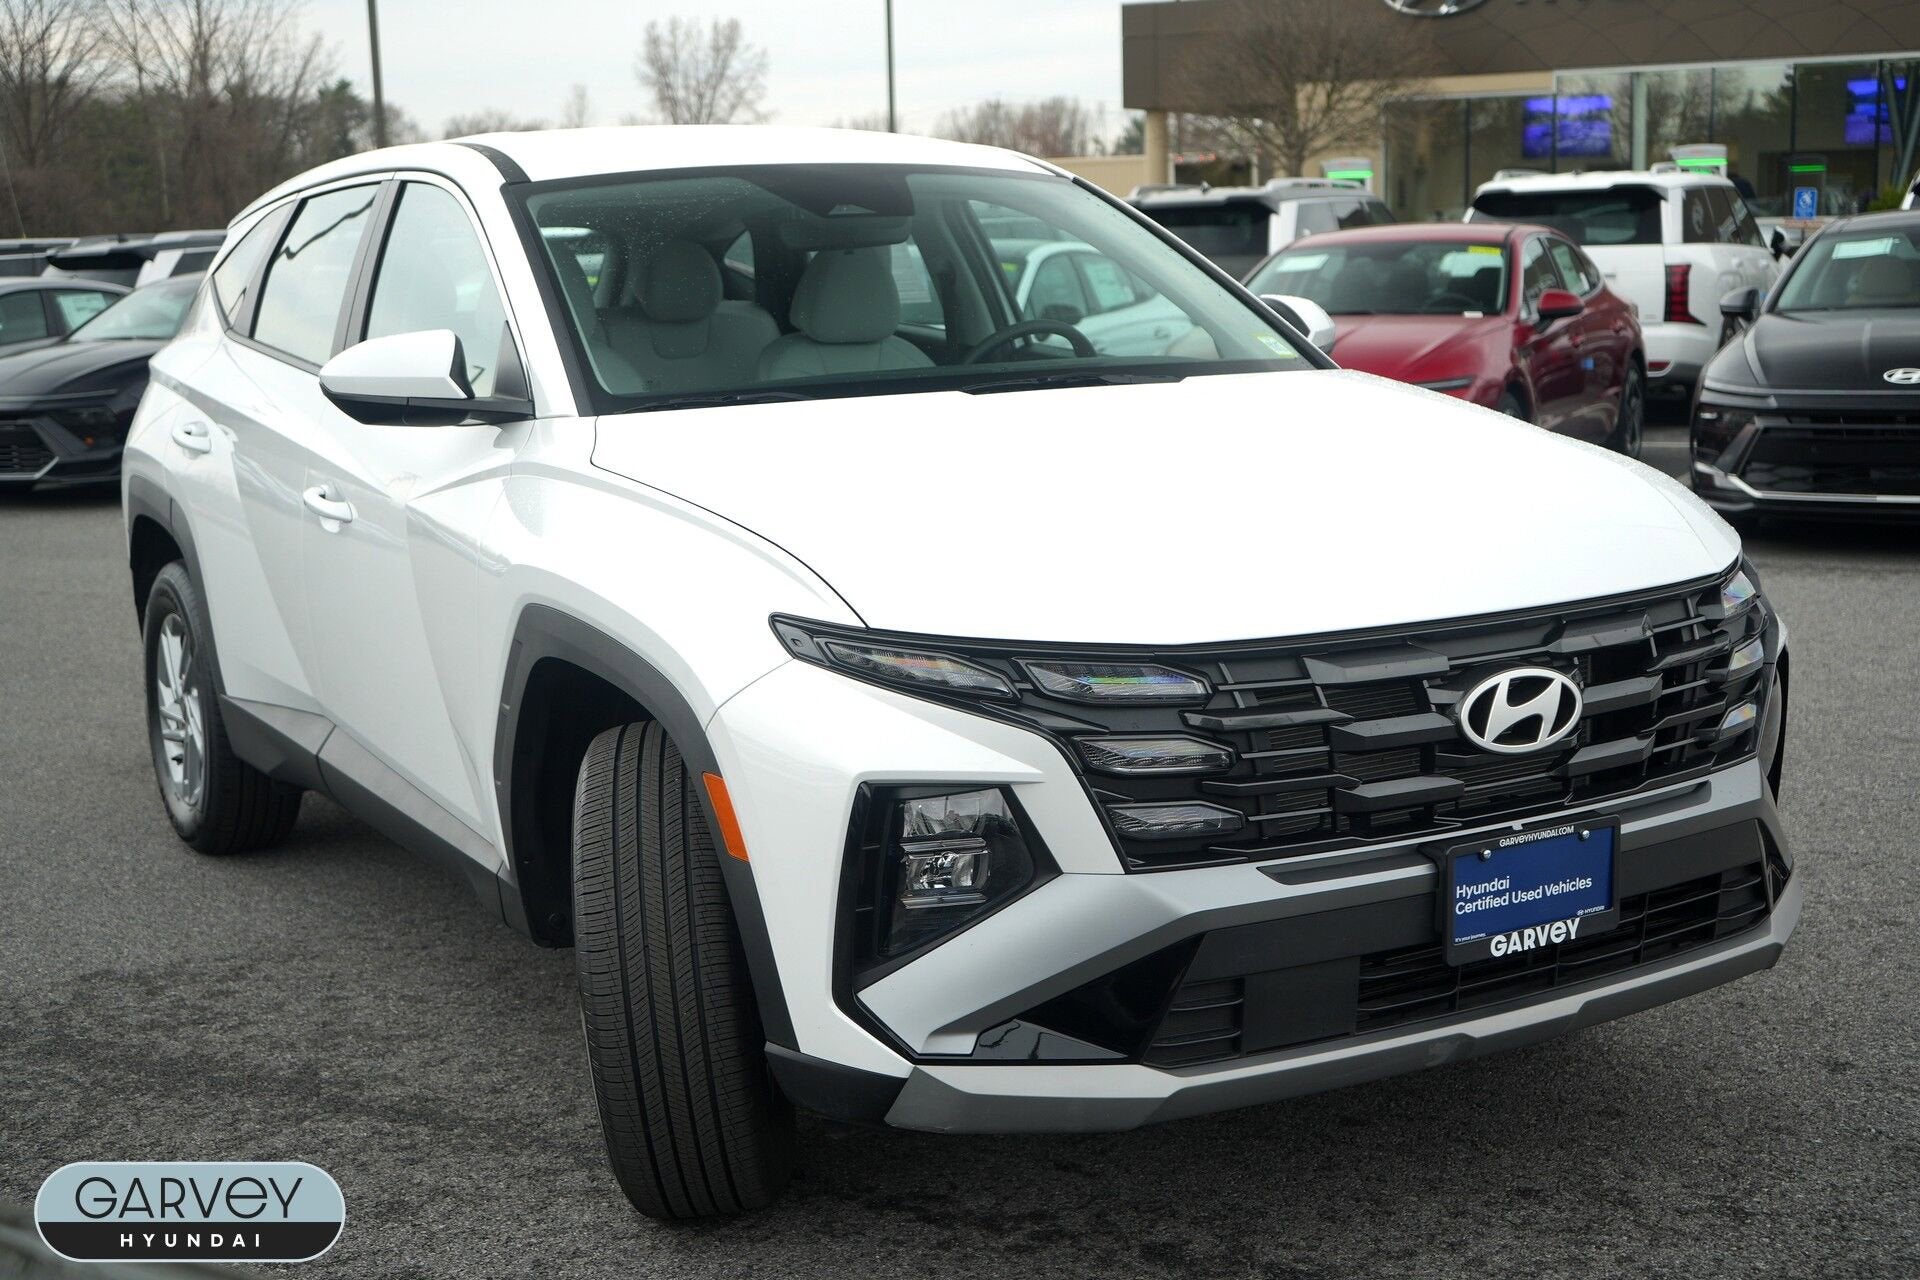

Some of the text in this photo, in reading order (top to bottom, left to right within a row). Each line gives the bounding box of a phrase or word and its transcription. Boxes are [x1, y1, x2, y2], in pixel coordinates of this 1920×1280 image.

[1455, 877, 1592, 915] Certified Used Vehicles
[1456, 876, 1510, 899] Hyundai
